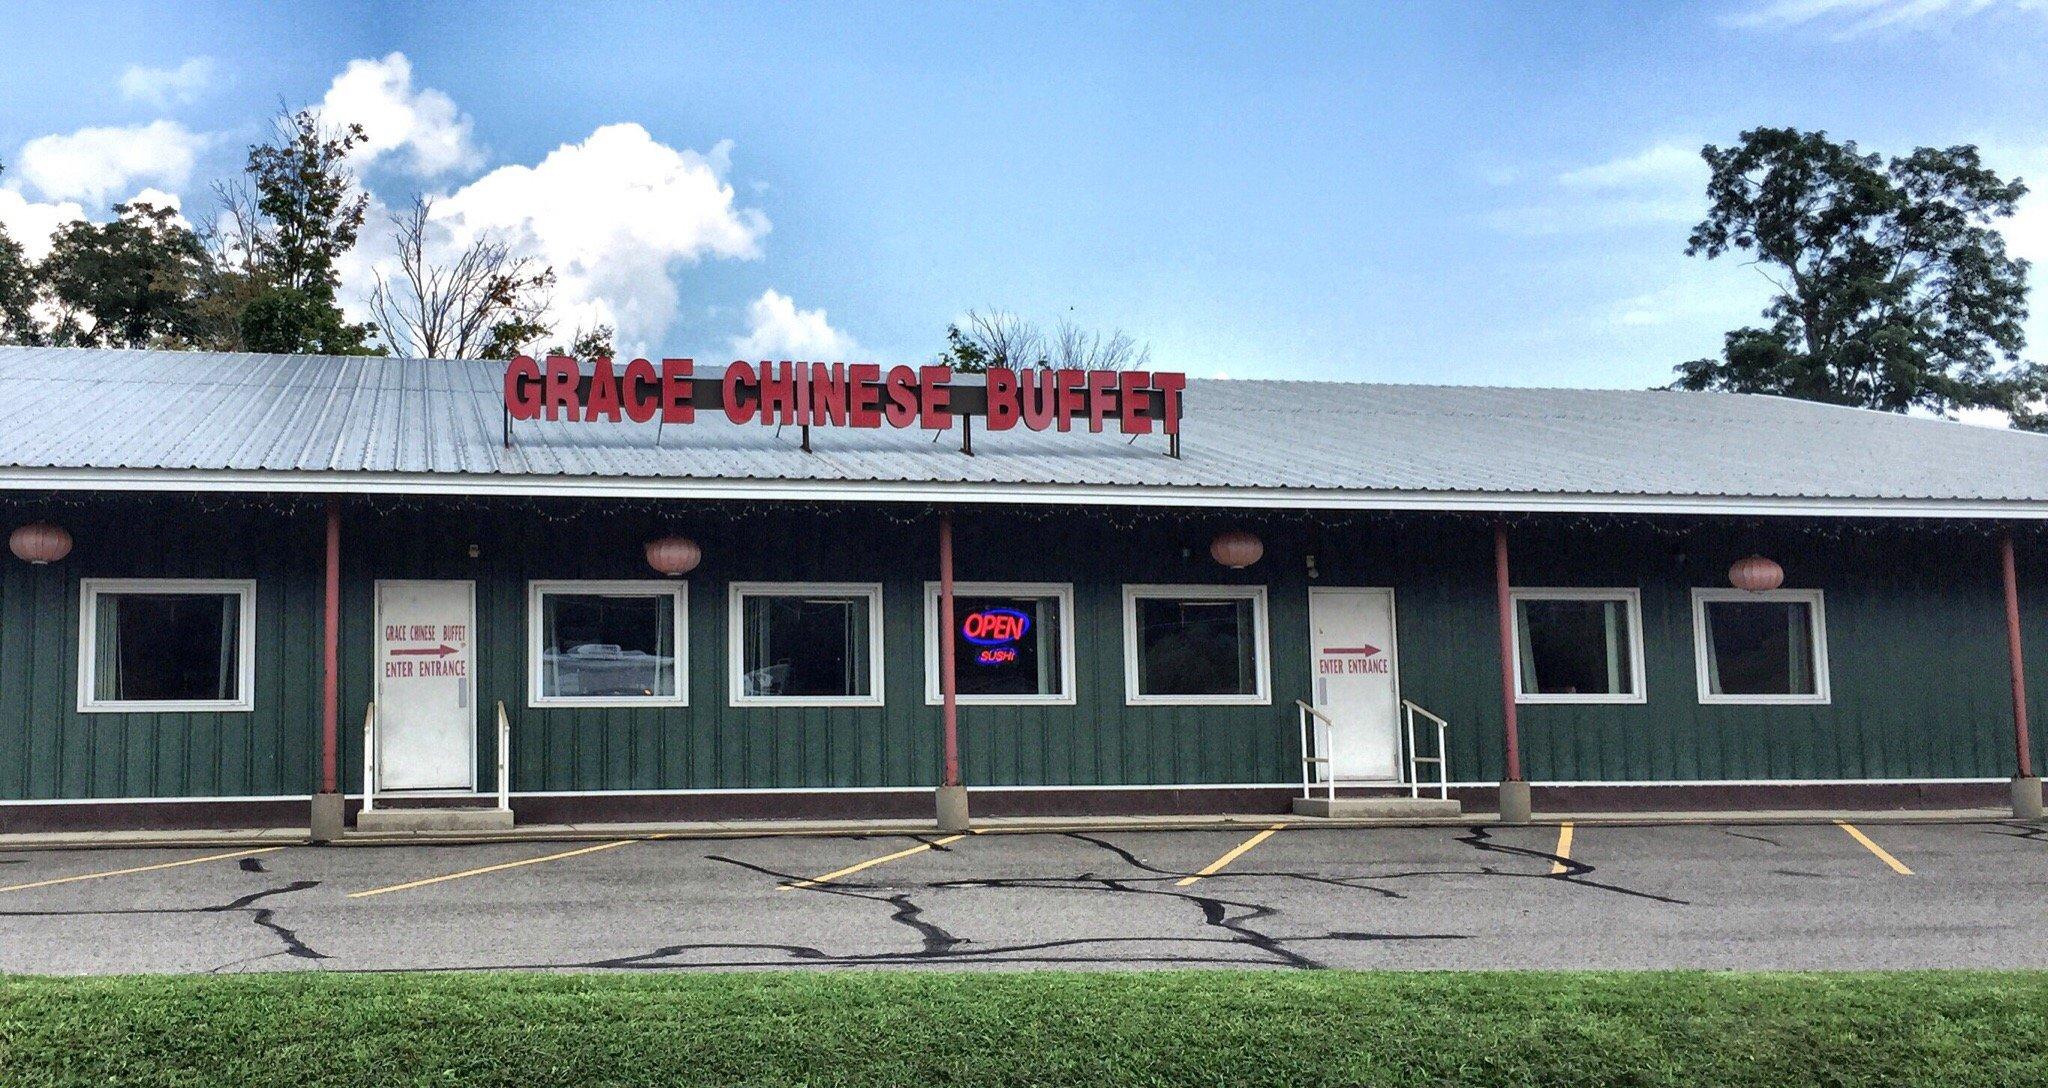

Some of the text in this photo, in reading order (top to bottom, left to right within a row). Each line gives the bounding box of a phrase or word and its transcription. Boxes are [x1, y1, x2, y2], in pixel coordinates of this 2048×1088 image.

[504, 355, 1186, 435] GRACE CHINESE BUFFET
[385, 625, 466, 641] GRACE CHINESE BUFFET
[964, 613, 1024, 640] OPEN
[385, 661, 466, 677] ENTER ENTRANCE
[1320, 659, 1388, 674] ENTER ENTRANCE
